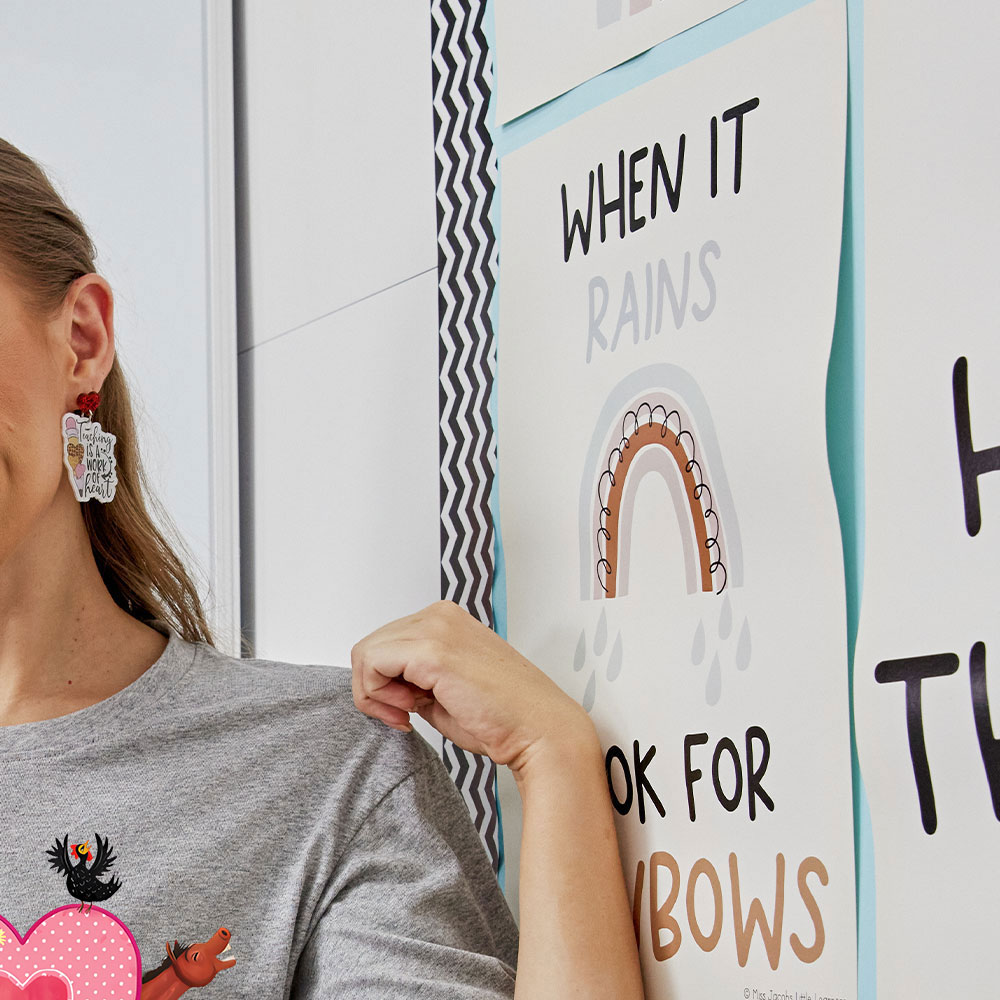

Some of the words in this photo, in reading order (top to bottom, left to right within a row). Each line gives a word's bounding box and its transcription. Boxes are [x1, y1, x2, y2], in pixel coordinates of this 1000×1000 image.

[561, 133, 686, 263] WHEN
[710, 97, 760, 198] IT
[585, 240, 721, 364] RAINS
[76, 419, 113, 453] Teaching
[86, 444, 93, 458] IS
[95, 445, 101, 459] A
[86, 458, 107, 472] WORK
[85, 473, 115, 499] heart
[91, 472, 101, 486] OF
[605, 739, 666, 824] OK
[684, 725, 775, 821] FOR
[632, 851, 829, 970] BOWS
[752, 988, 766, 1000] Miss
